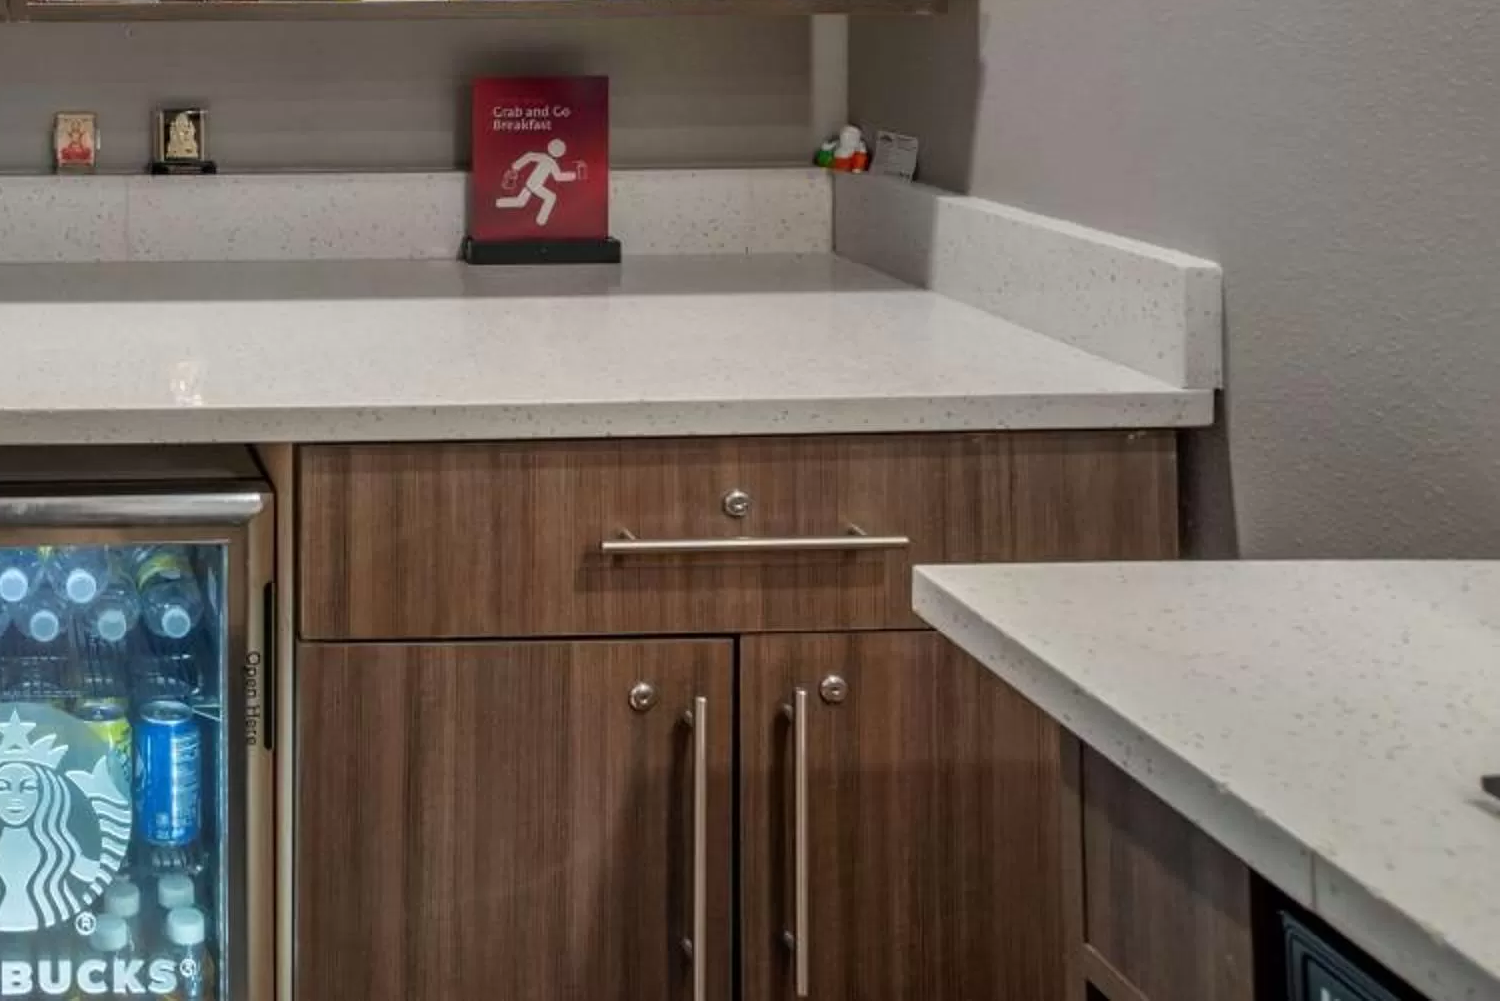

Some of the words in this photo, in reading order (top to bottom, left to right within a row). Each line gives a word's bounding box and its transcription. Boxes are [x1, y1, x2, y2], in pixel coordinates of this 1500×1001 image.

[492, 106, 523, 118] Grab
[525, 105, 549, 118] and
[552, 105, 571, 118] Go
[493, 118, 552, 131] Breakfast
[243, 651, 261, 698] Open
[244, 705, 261, 746] Here
